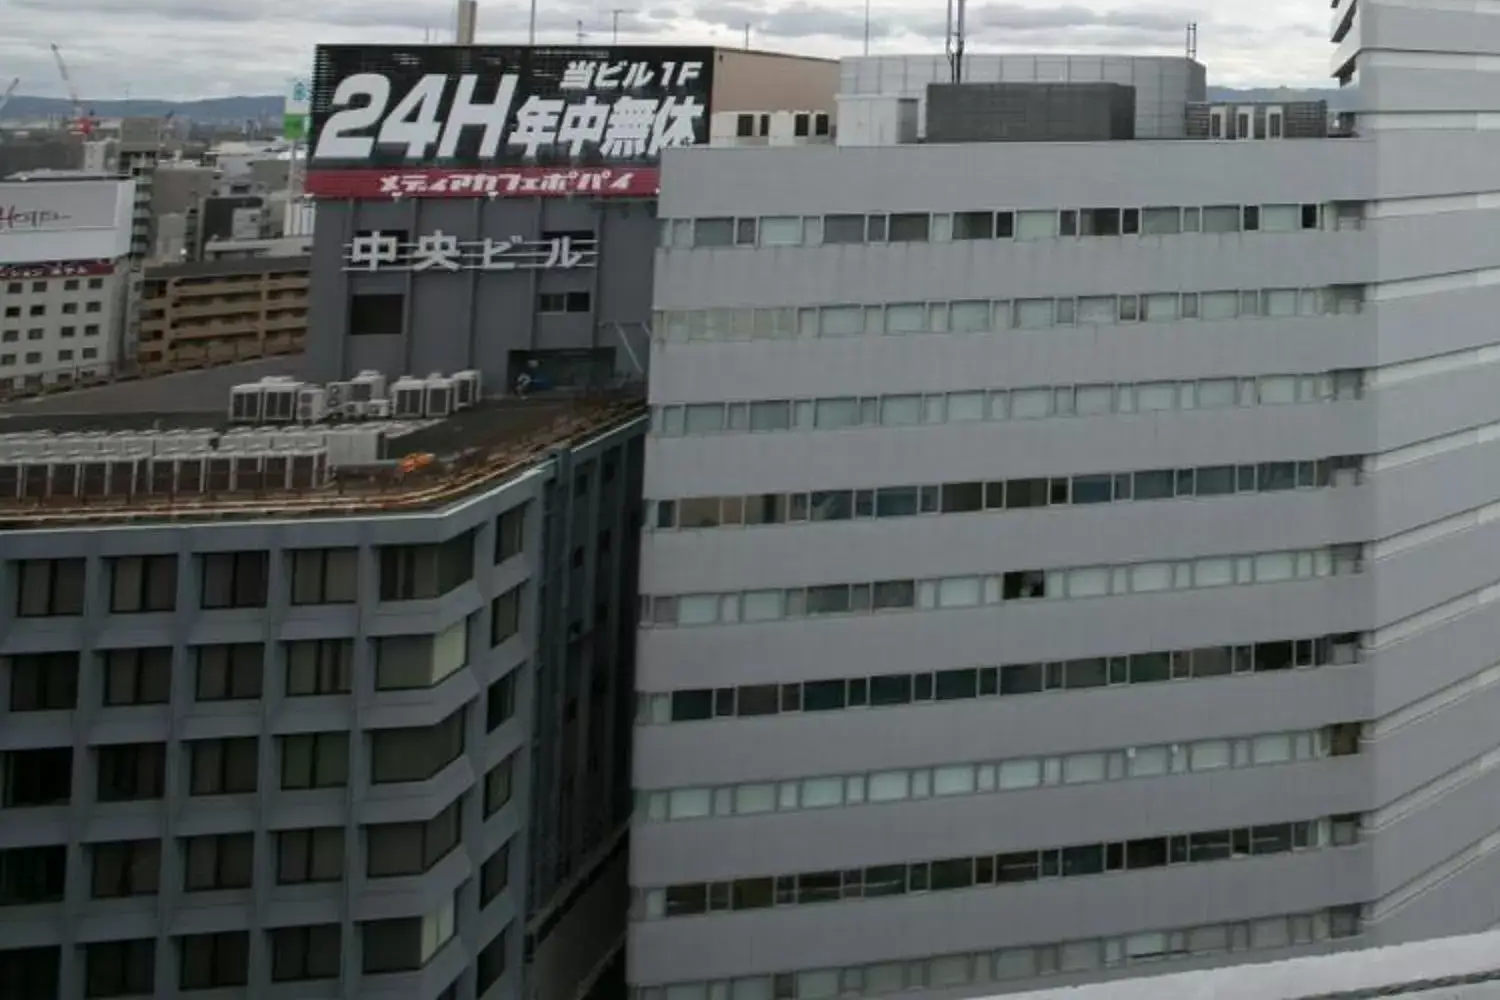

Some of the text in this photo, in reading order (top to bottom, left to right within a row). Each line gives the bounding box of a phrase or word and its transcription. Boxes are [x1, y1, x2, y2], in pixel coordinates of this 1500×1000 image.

[314, 73, 704, 158] 24H 年中無休
[352, 230, 582, 271] 中央ビル
